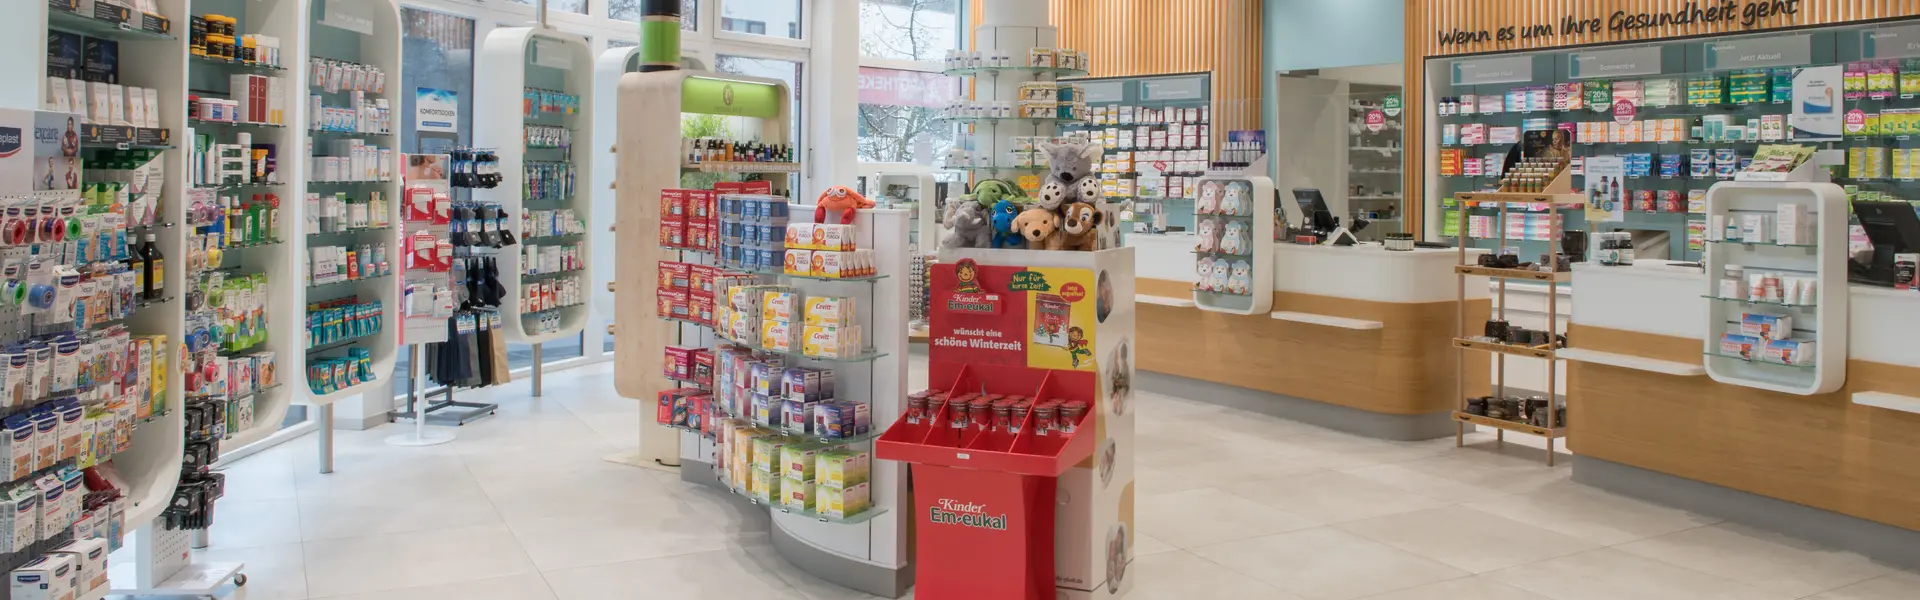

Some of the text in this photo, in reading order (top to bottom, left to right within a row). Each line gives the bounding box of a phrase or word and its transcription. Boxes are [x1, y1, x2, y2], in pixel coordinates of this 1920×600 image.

[1438, 0, 1799, 47] Wenn es um Ihre Gesundheit geht
[1739, 54, 1756, 62] Jetzt
[1616, 103, 1632, 111] 20%
[1012, 273, 1042, 283] Nur für
[1029, 282, 1044, 291] Zeit!
[953, 294, 982, 303] Kinder
[813, 332, 830, 340] Cevitt
[953, 328, 1003, 338] wünscht eine
[934, 336, 1022, 351] schöne Winterzeit
[938, 498, 986, 514] Kinder
